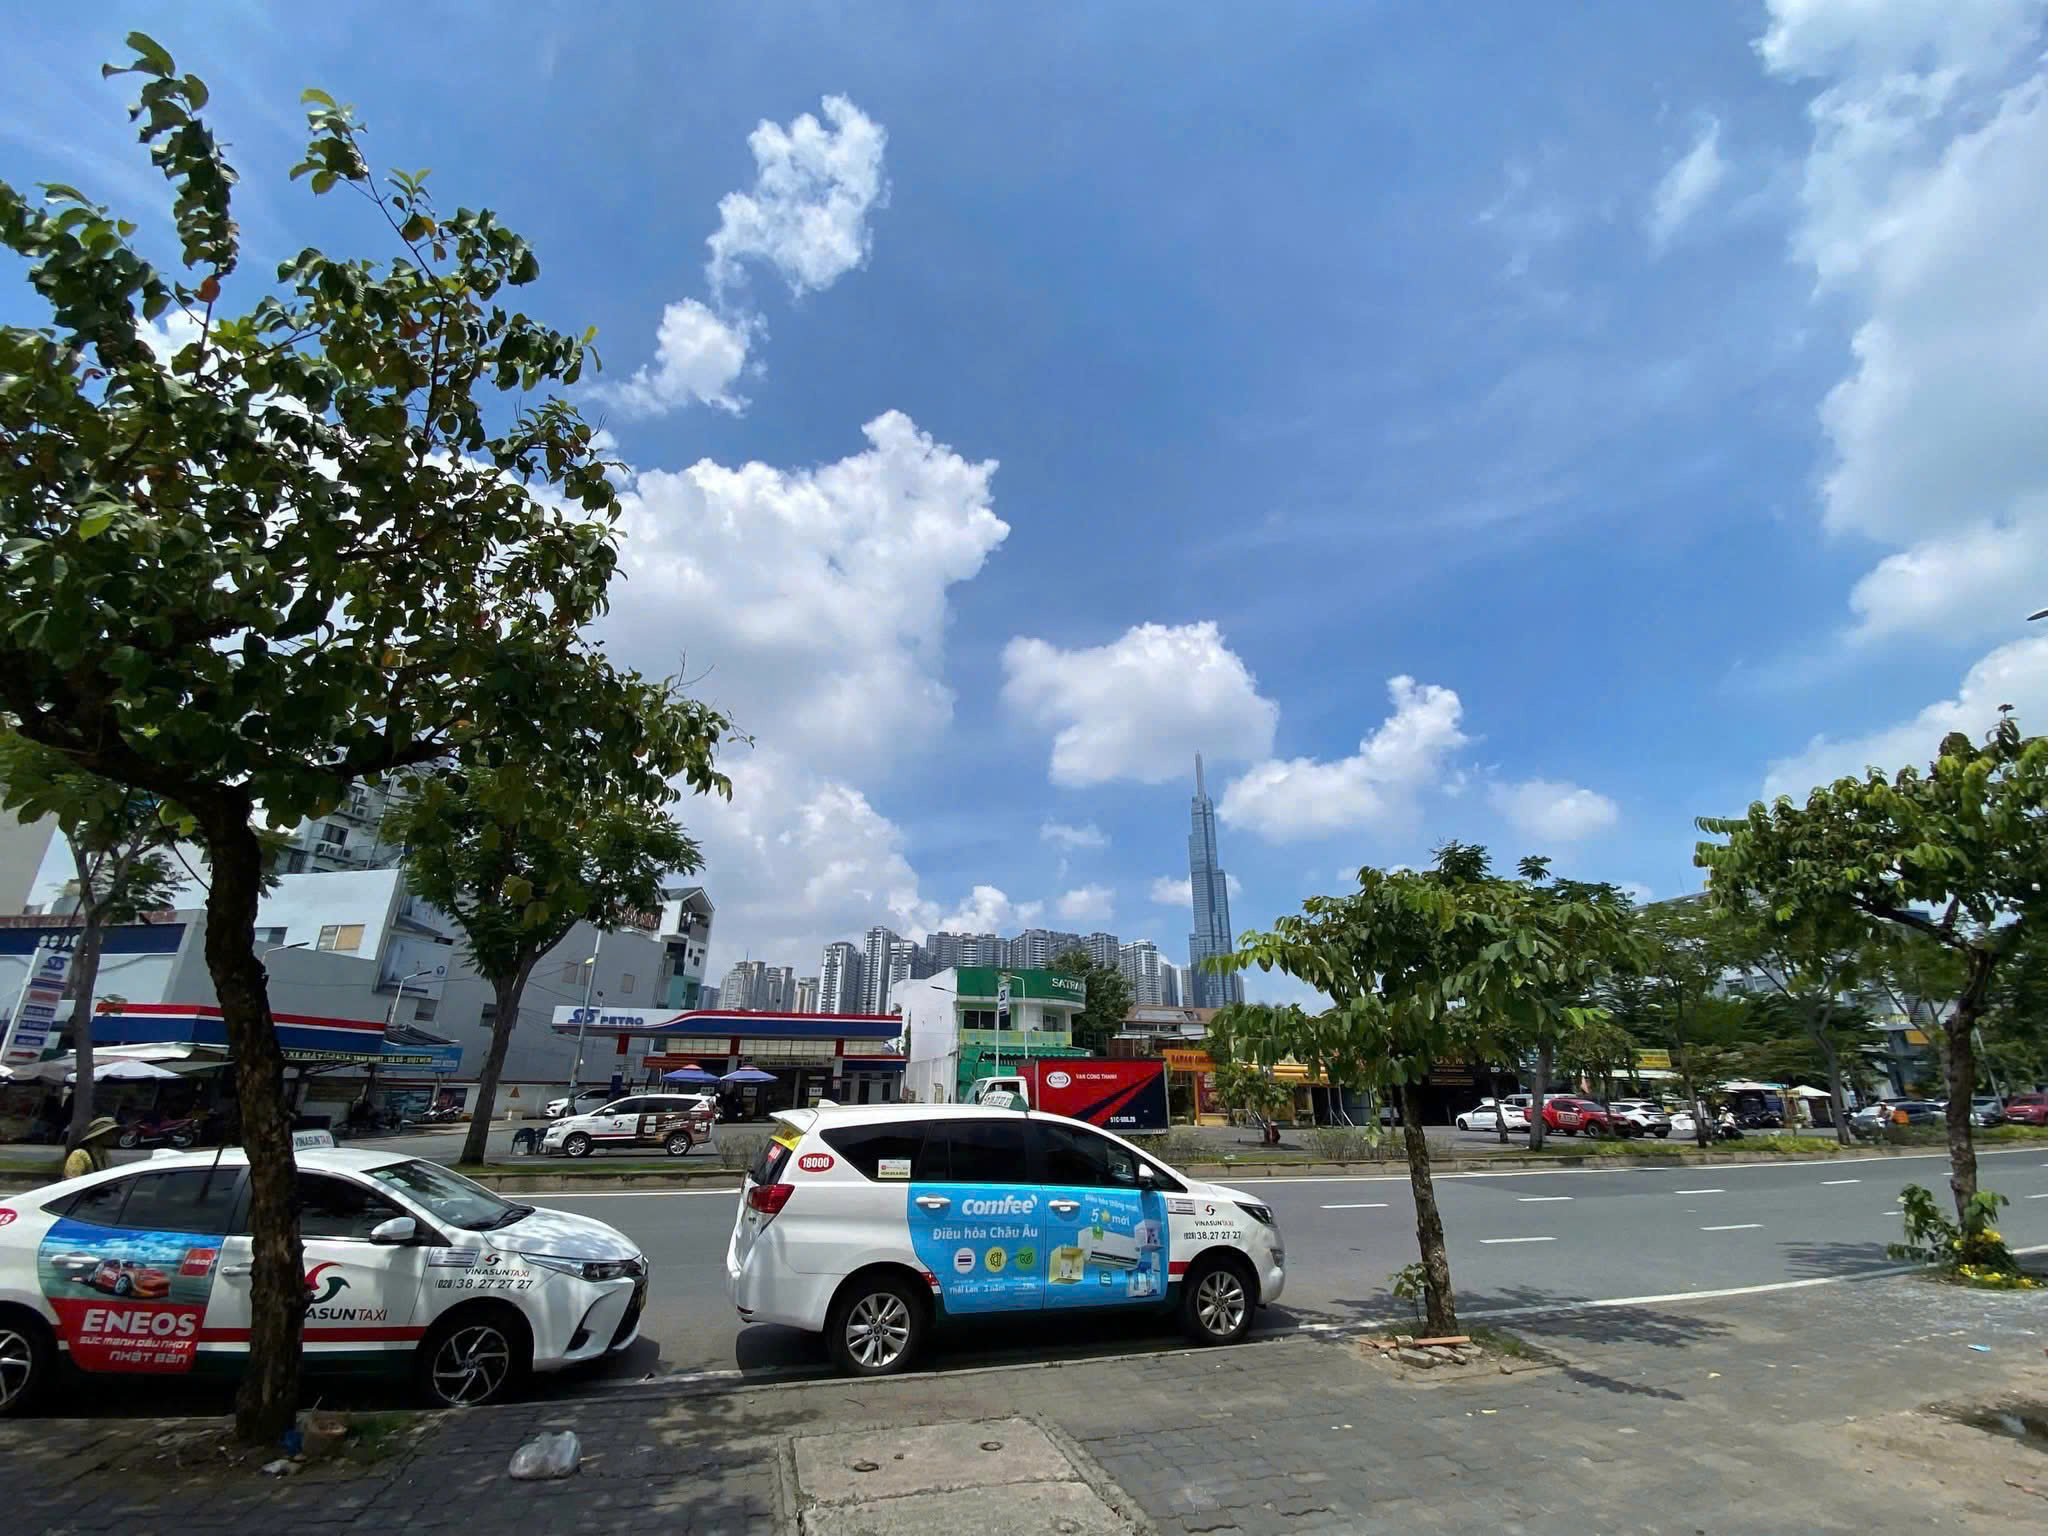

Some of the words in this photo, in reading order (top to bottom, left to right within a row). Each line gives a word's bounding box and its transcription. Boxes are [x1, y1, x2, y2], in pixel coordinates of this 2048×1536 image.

[600, 1015, 644, 1025] PETRO
[802, 1157, 830, 1169] 18000
[1091, 1208, 1100, 1222] 5
[933, 1226, 961, 1241] Điều
[964, 1225, 987, 1240] hòa
[989, 1225, 1020, 1240] Châu
[1022, 1223, 1039, 1238] Âu
[465, 1268, 530, 1278] VINASUNTAXI
[81, 1308, 197, 1337] ENEOS
